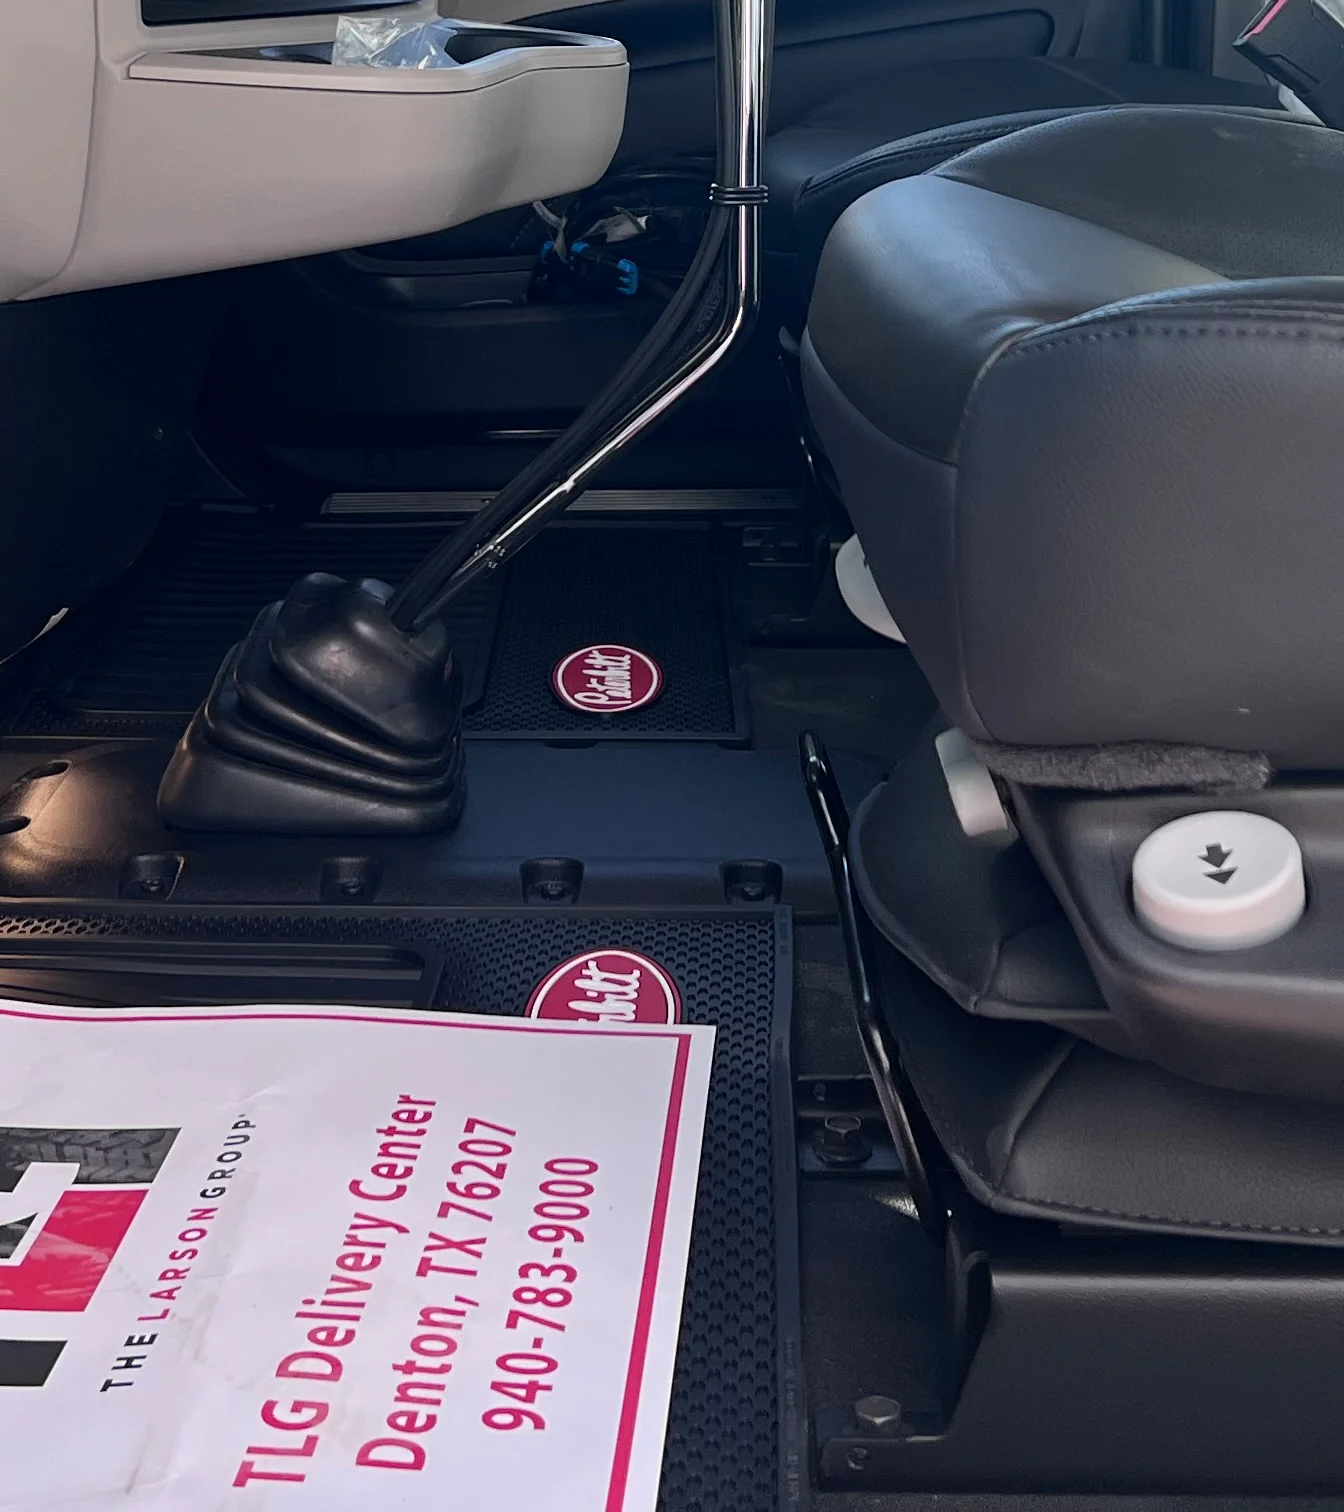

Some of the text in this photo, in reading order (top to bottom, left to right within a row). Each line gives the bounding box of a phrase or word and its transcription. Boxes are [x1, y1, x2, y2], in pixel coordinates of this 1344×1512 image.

[100, 1118, 256, 1393] THE LARSON GROUP
[232, 1094, 436, 1487] TLG Delivery Center
[356, 1118, 516, 1471] Denton, TX 76207
[482, 1157, 599, 1431] 940-783-9000
